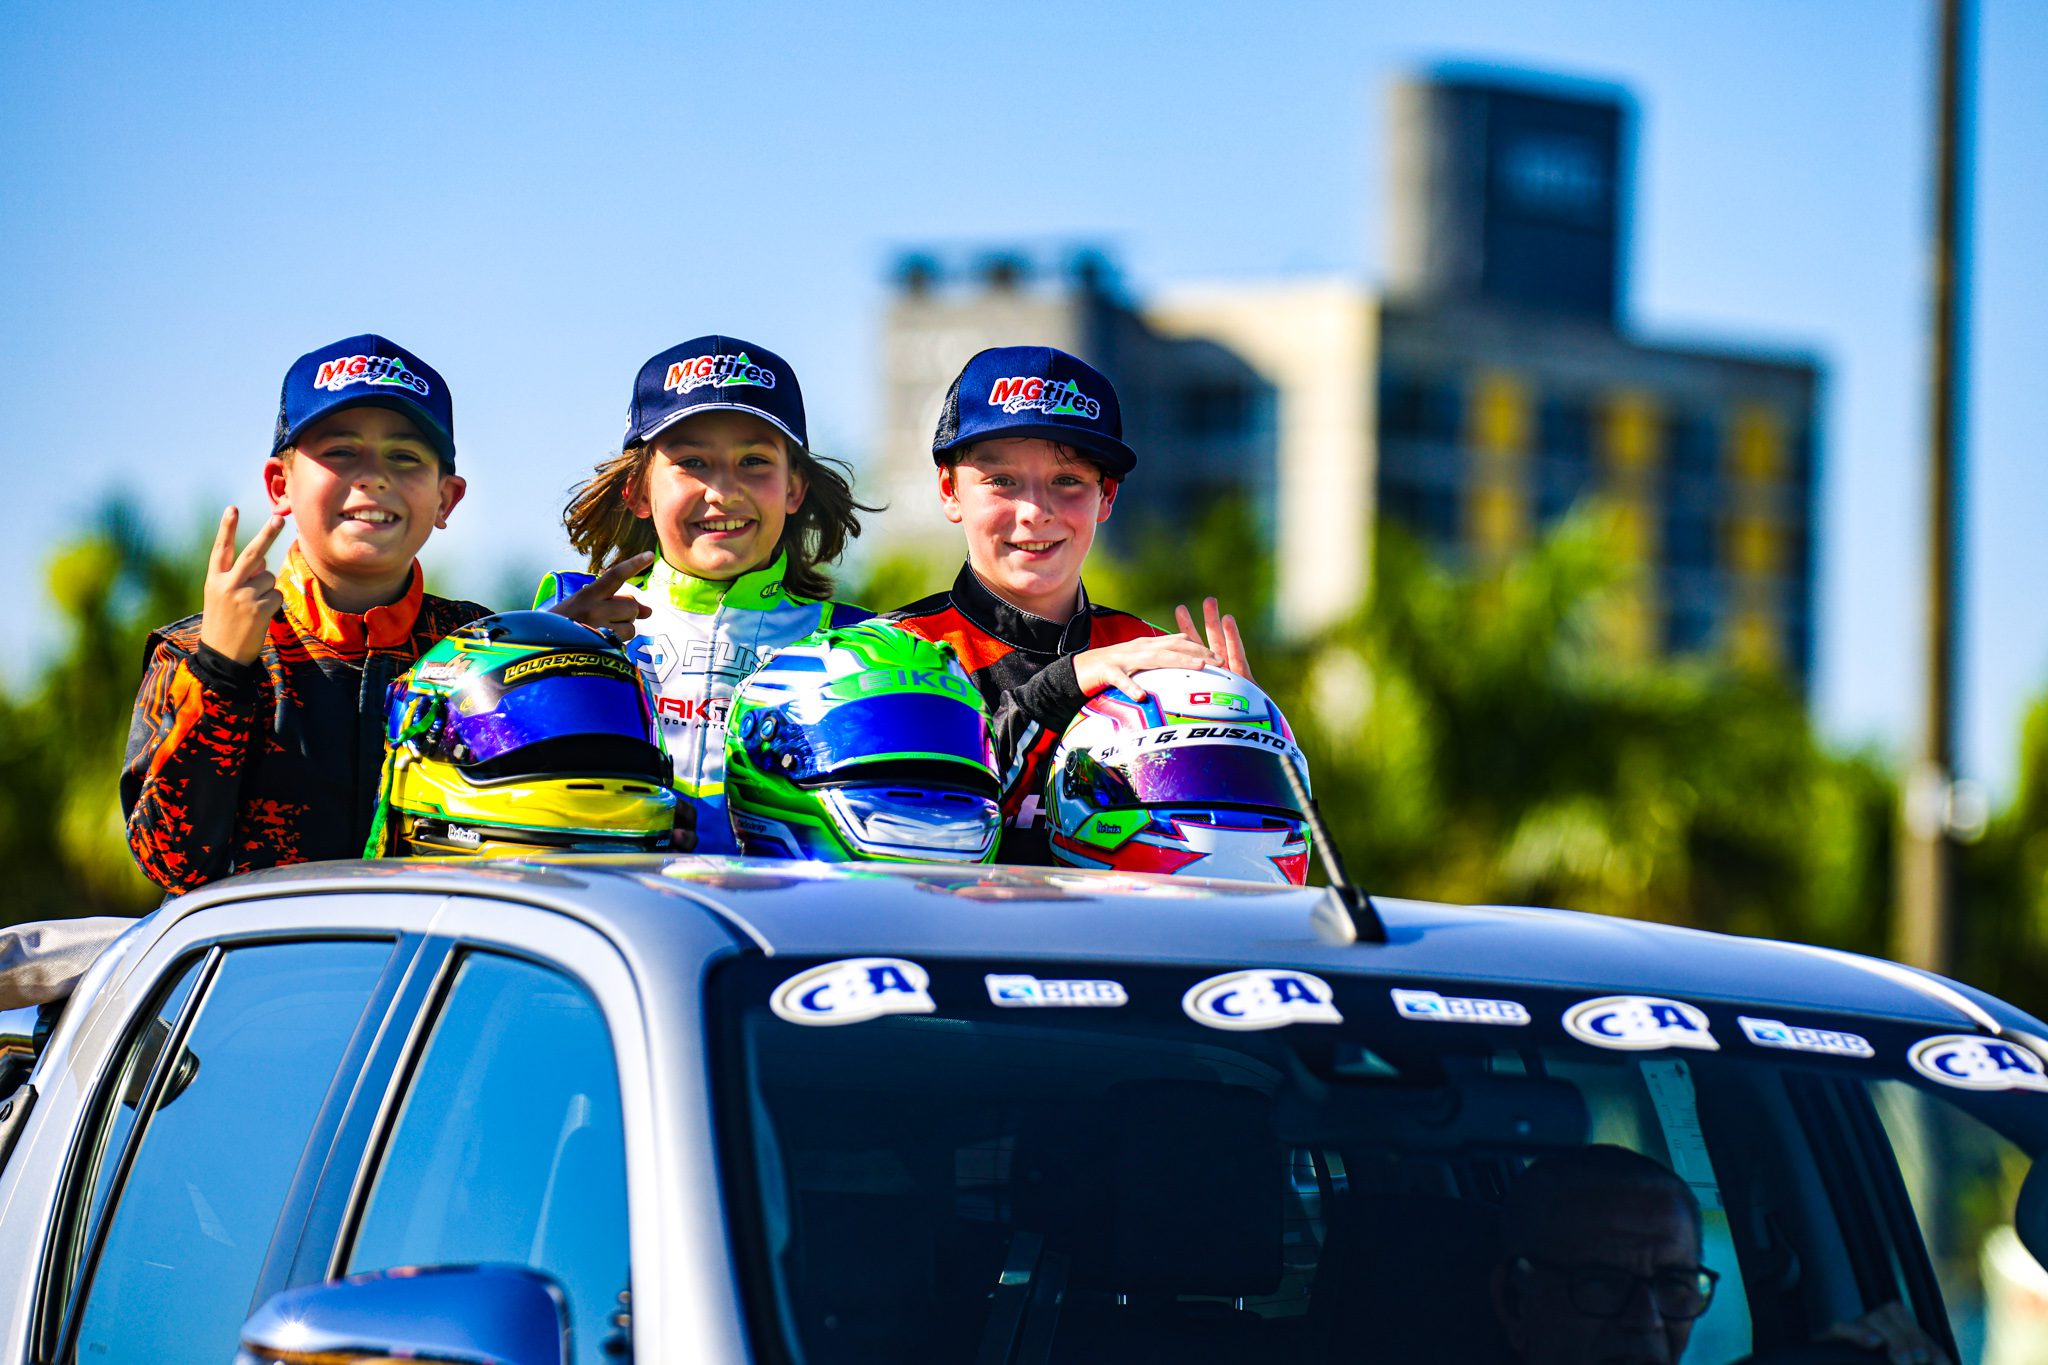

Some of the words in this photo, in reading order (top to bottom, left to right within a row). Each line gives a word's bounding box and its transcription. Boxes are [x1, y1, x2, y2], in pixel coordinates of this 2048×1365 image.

[991, 379, 1099, 418] MGtires
[859, 669, 967, 697] EIKO
[1155, 729, 1179, 744] G.
[1186, 727, 1286, 751] BUSATO
[1039, 982, 1120, 999] BRB
[1444, 999, 1522, 1019] BRB
[1790, 1028, 1868, 1053] BRB
